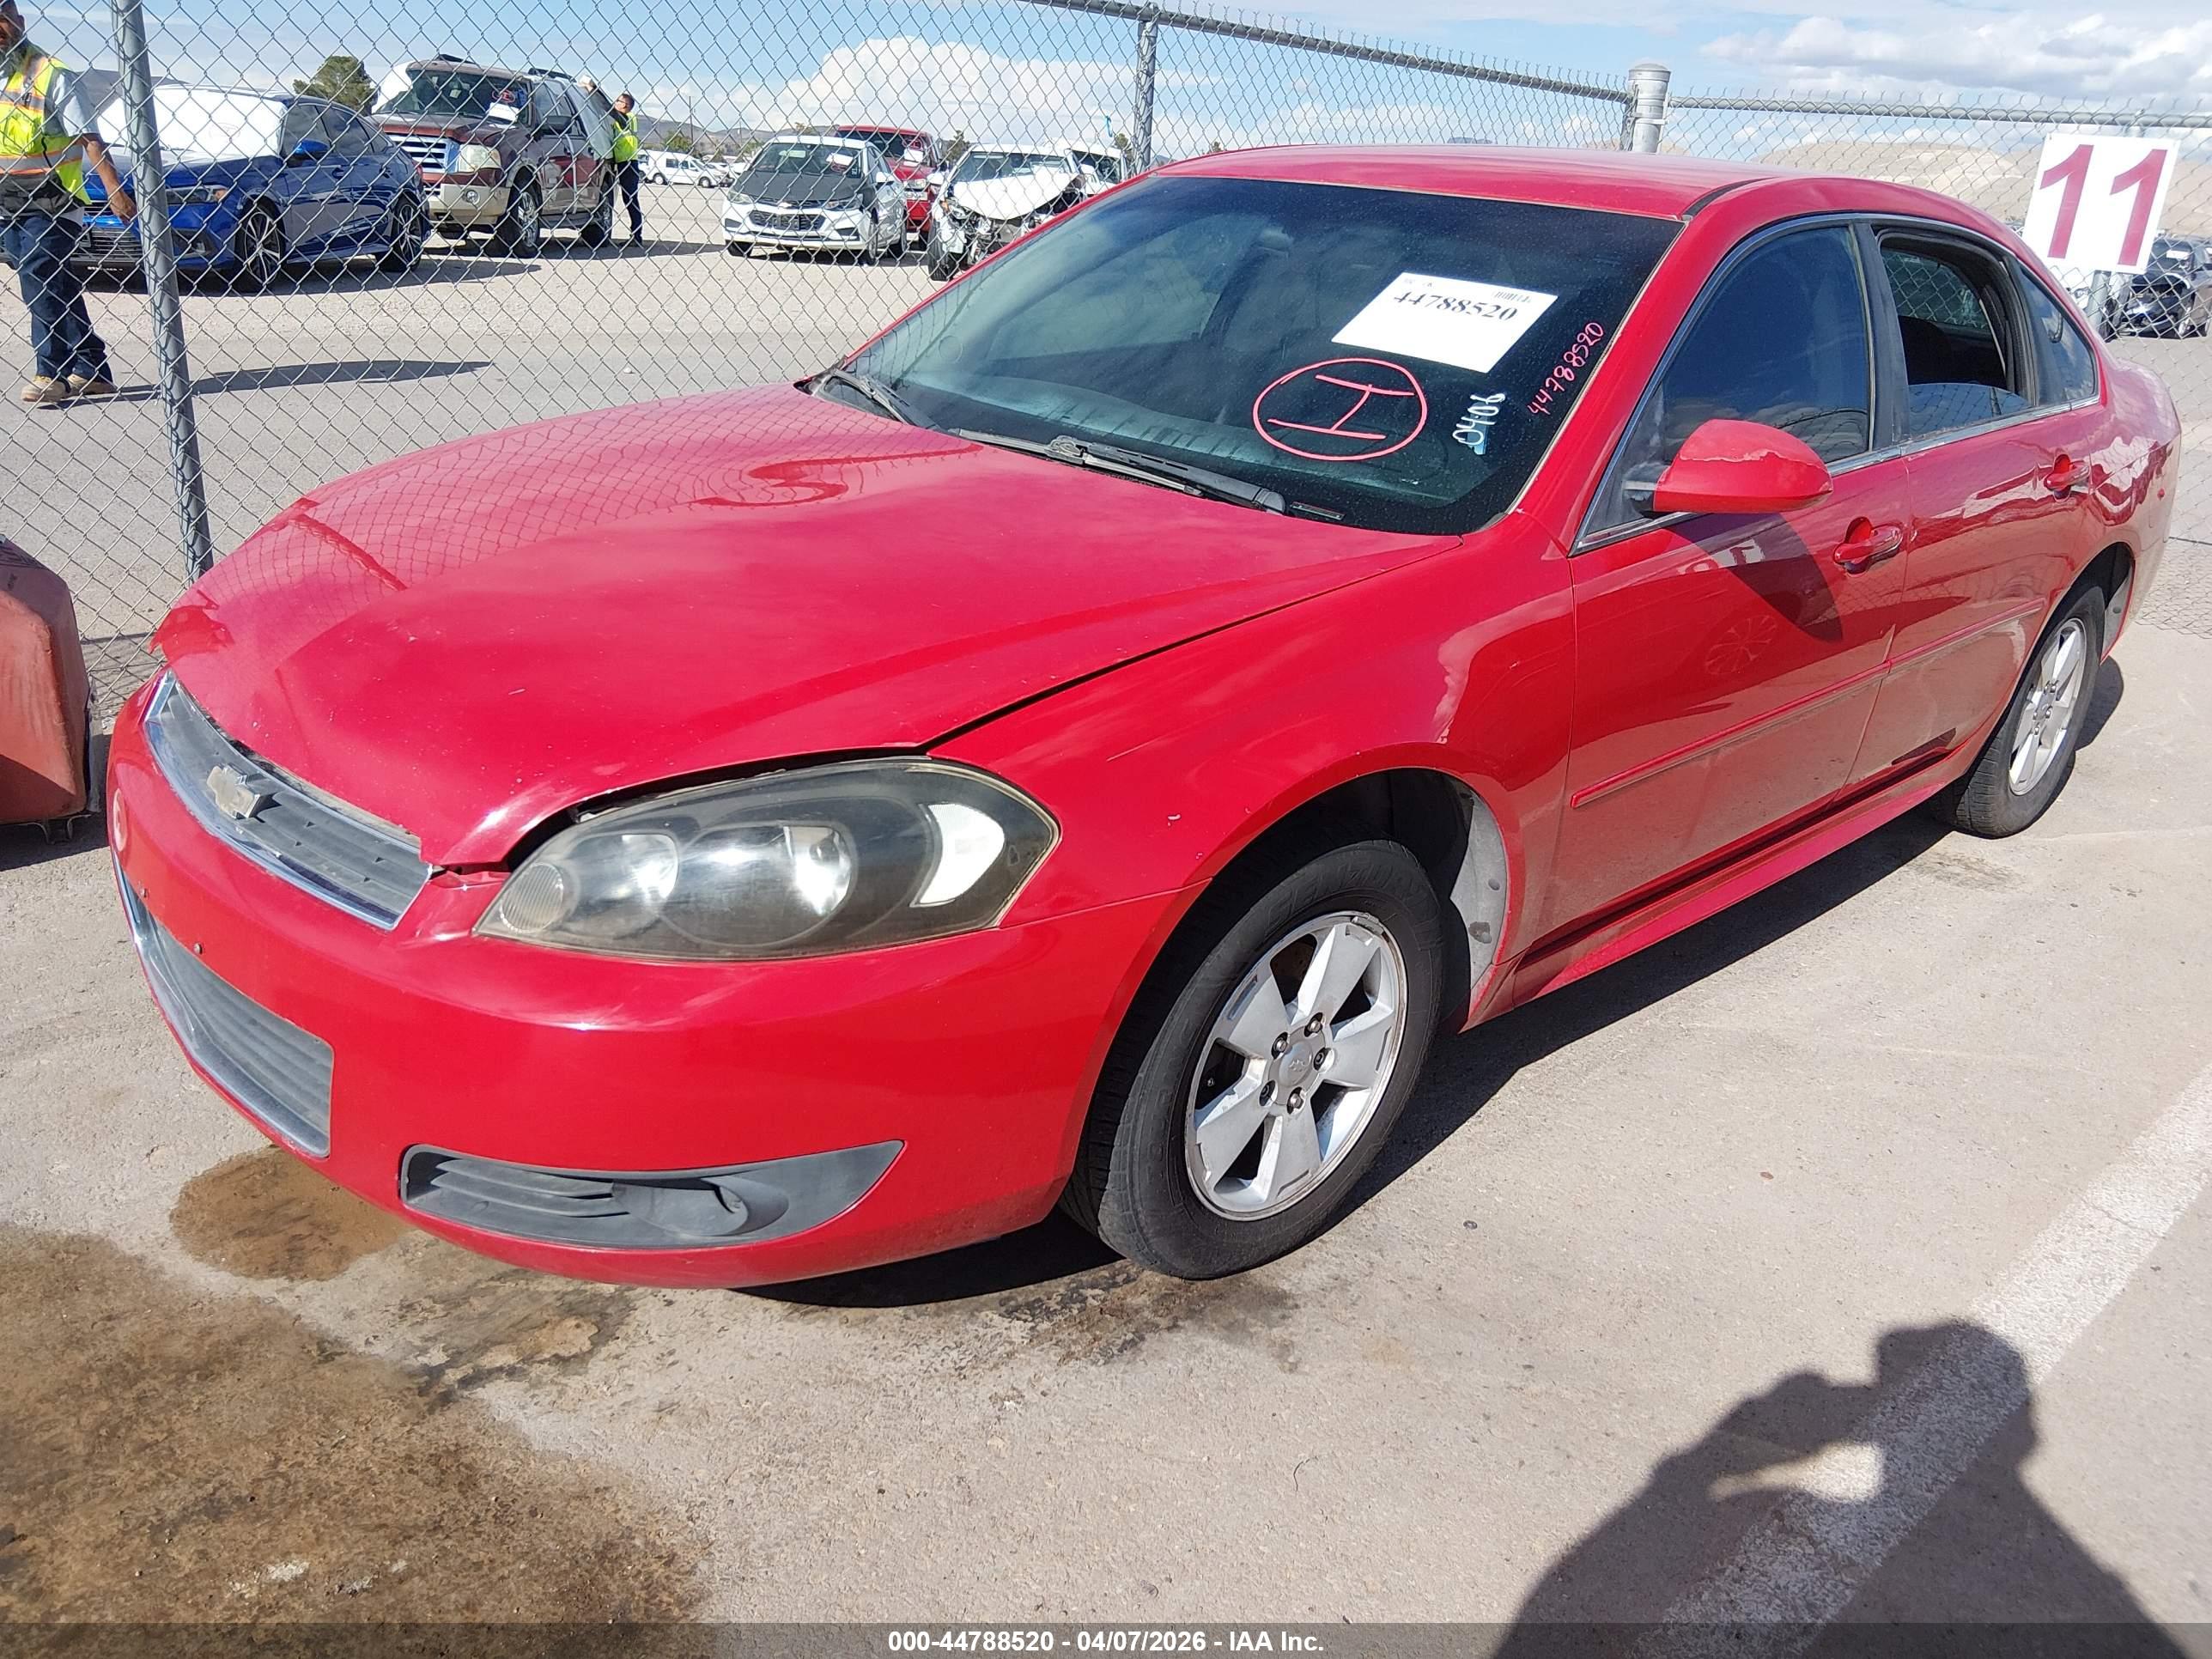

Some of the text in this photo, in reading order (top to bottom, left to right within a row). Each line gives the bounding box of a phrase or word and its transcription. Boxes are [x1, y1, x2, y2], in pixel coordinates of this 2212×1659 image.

[2039, 144, 2168, 266] 11
[1394, 291, 1518, 321] 44788520
[1527, 322, 1604, 415] 44788520
